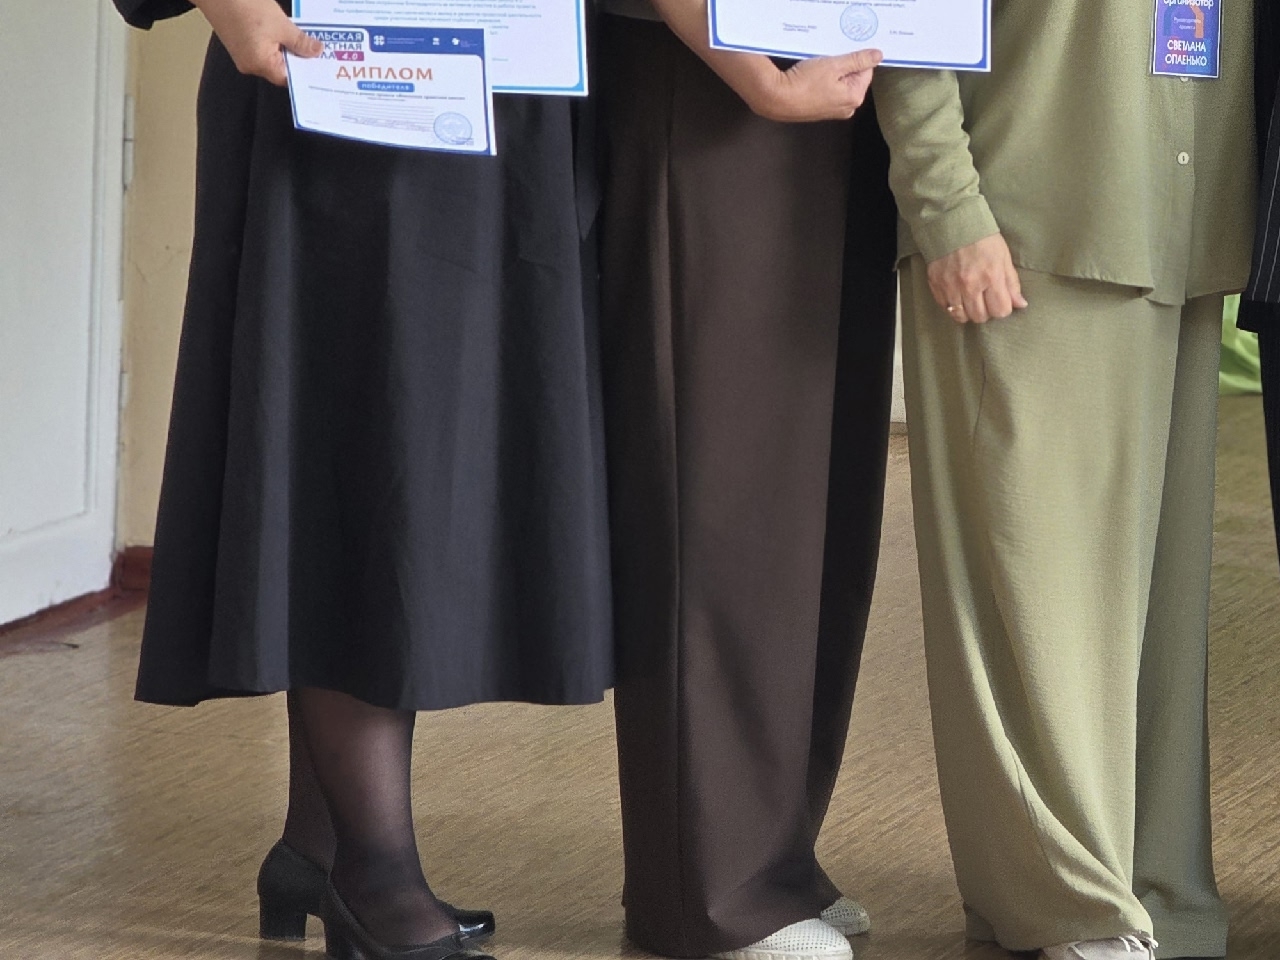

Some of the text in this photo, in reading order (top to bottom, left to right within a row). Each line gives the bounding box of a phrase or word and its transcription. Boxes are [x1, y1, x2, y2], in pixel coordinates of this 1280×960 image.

[305, 31, 362, 41] АЛЬСКАЯ
[324, 42, 362, 51] КТНАЯ
[1167, 39, 1206, 52] СВЕТЛАНА
[341, 52, 358, 60] 4.0
[336, 66, 433, 81] ДИПЛОМ
